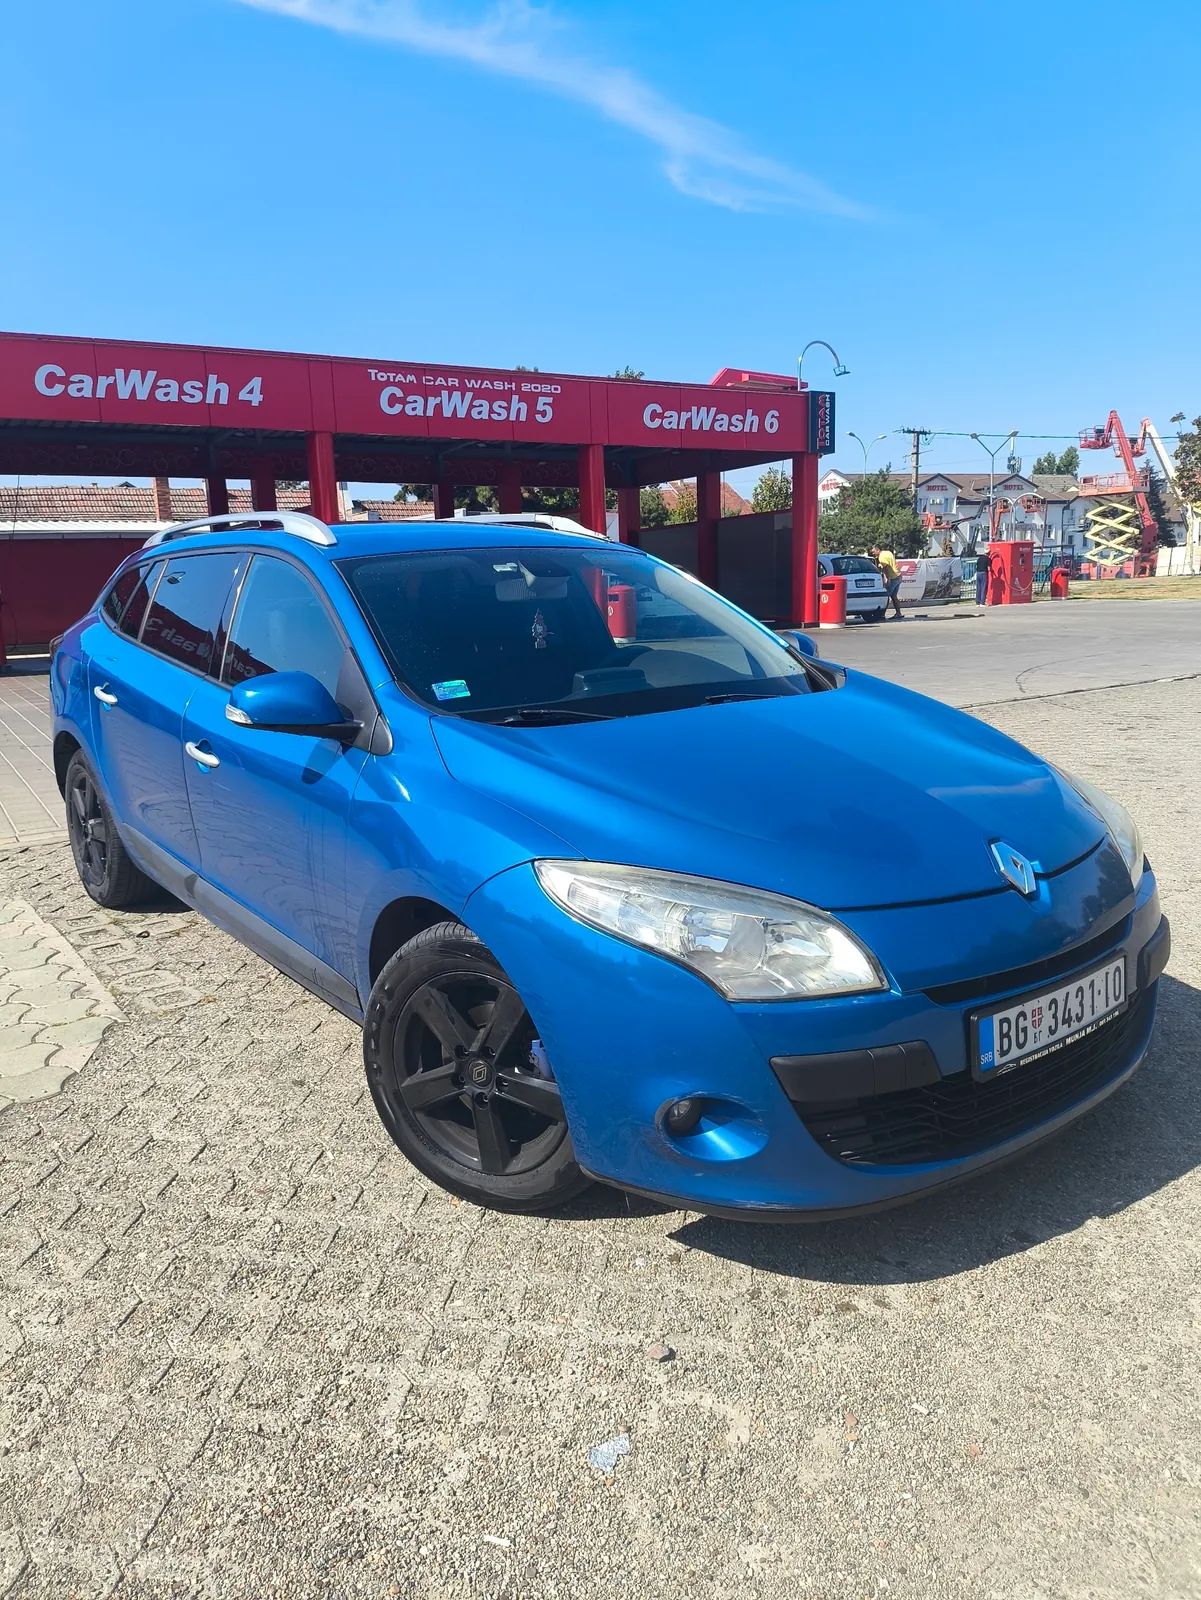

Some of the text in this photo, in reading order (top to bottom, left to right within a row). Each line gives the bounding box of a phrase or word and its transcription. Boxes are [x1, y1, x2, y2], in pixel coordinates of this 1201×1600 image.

[34, 363, 264, 407] CarWash 4
[422, 375, 460, 387] CAR
[464, 379, 516, 391] WASH
[521, 383, 562, 394] 2020
[379, 386, 554, 423] CarWash 5
[643, 403, 780, 434] CarWash 6
[998, 1010, 1028, 1058] BG
[980, 1051, 993, 1065] SRB
